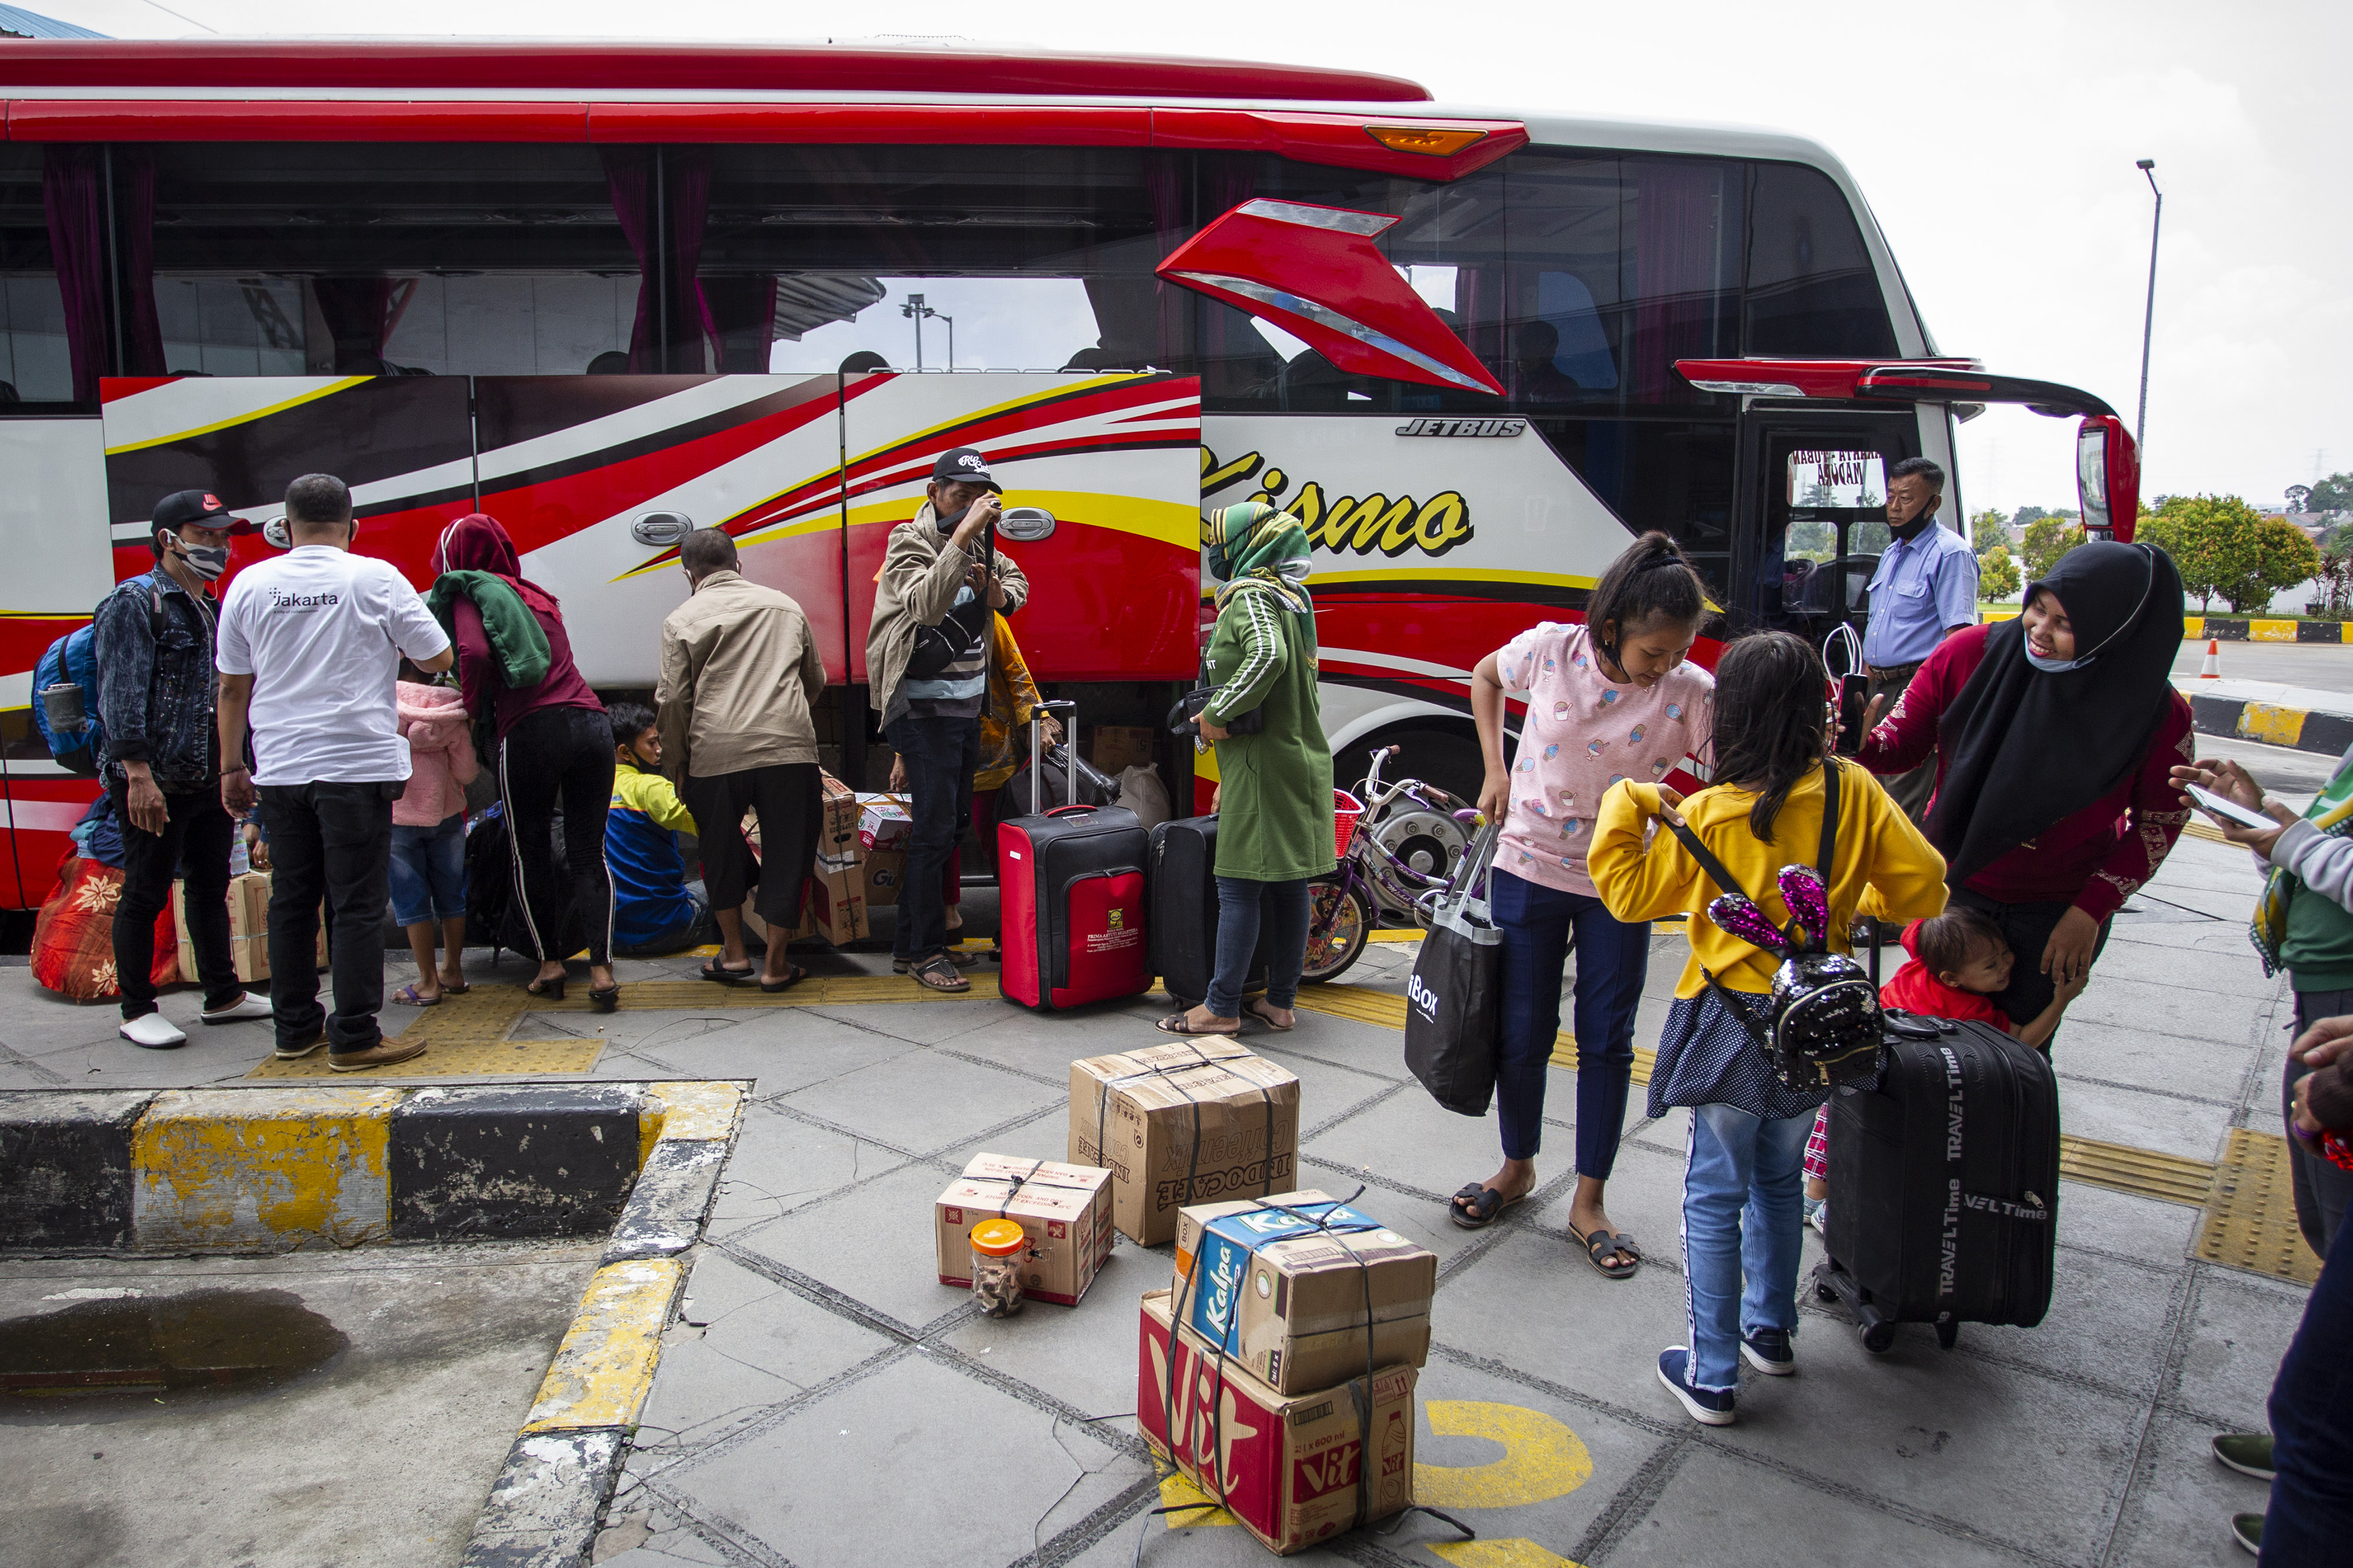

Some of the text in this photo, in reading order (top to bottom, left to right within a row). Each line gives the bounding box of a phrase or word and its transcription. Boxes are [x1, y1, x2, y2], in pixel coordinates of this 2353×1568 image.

[1397, 419, 1525, 437] JETBUS
[958, 455, 979, 466] Rip
[1408, 974, 1438, 1016] iBox
[1940, 1047, 1964, 1162] TRAVEL Time
[1020, 1199, 1056, 1208] EXCEEDING
[1943, 1178, 1961, 1224] Time
[2002, 1201, 2048, 1220] Time
[1181, 1220, 1189, 1243] BOX
[1940, 1228, 1957, 1296] TRAVEL
[1206, 1245, 1232, 1337] Kalpa
[1149, 1333, 1258, 1496] Vit
[1314, 1436, 1333, 1449] 600
[1334, 1430, 1345, 1442] ml
[1301, 1444, 1361, 1493] Vit
[1382, 1454, 1404, 1470] Vit
